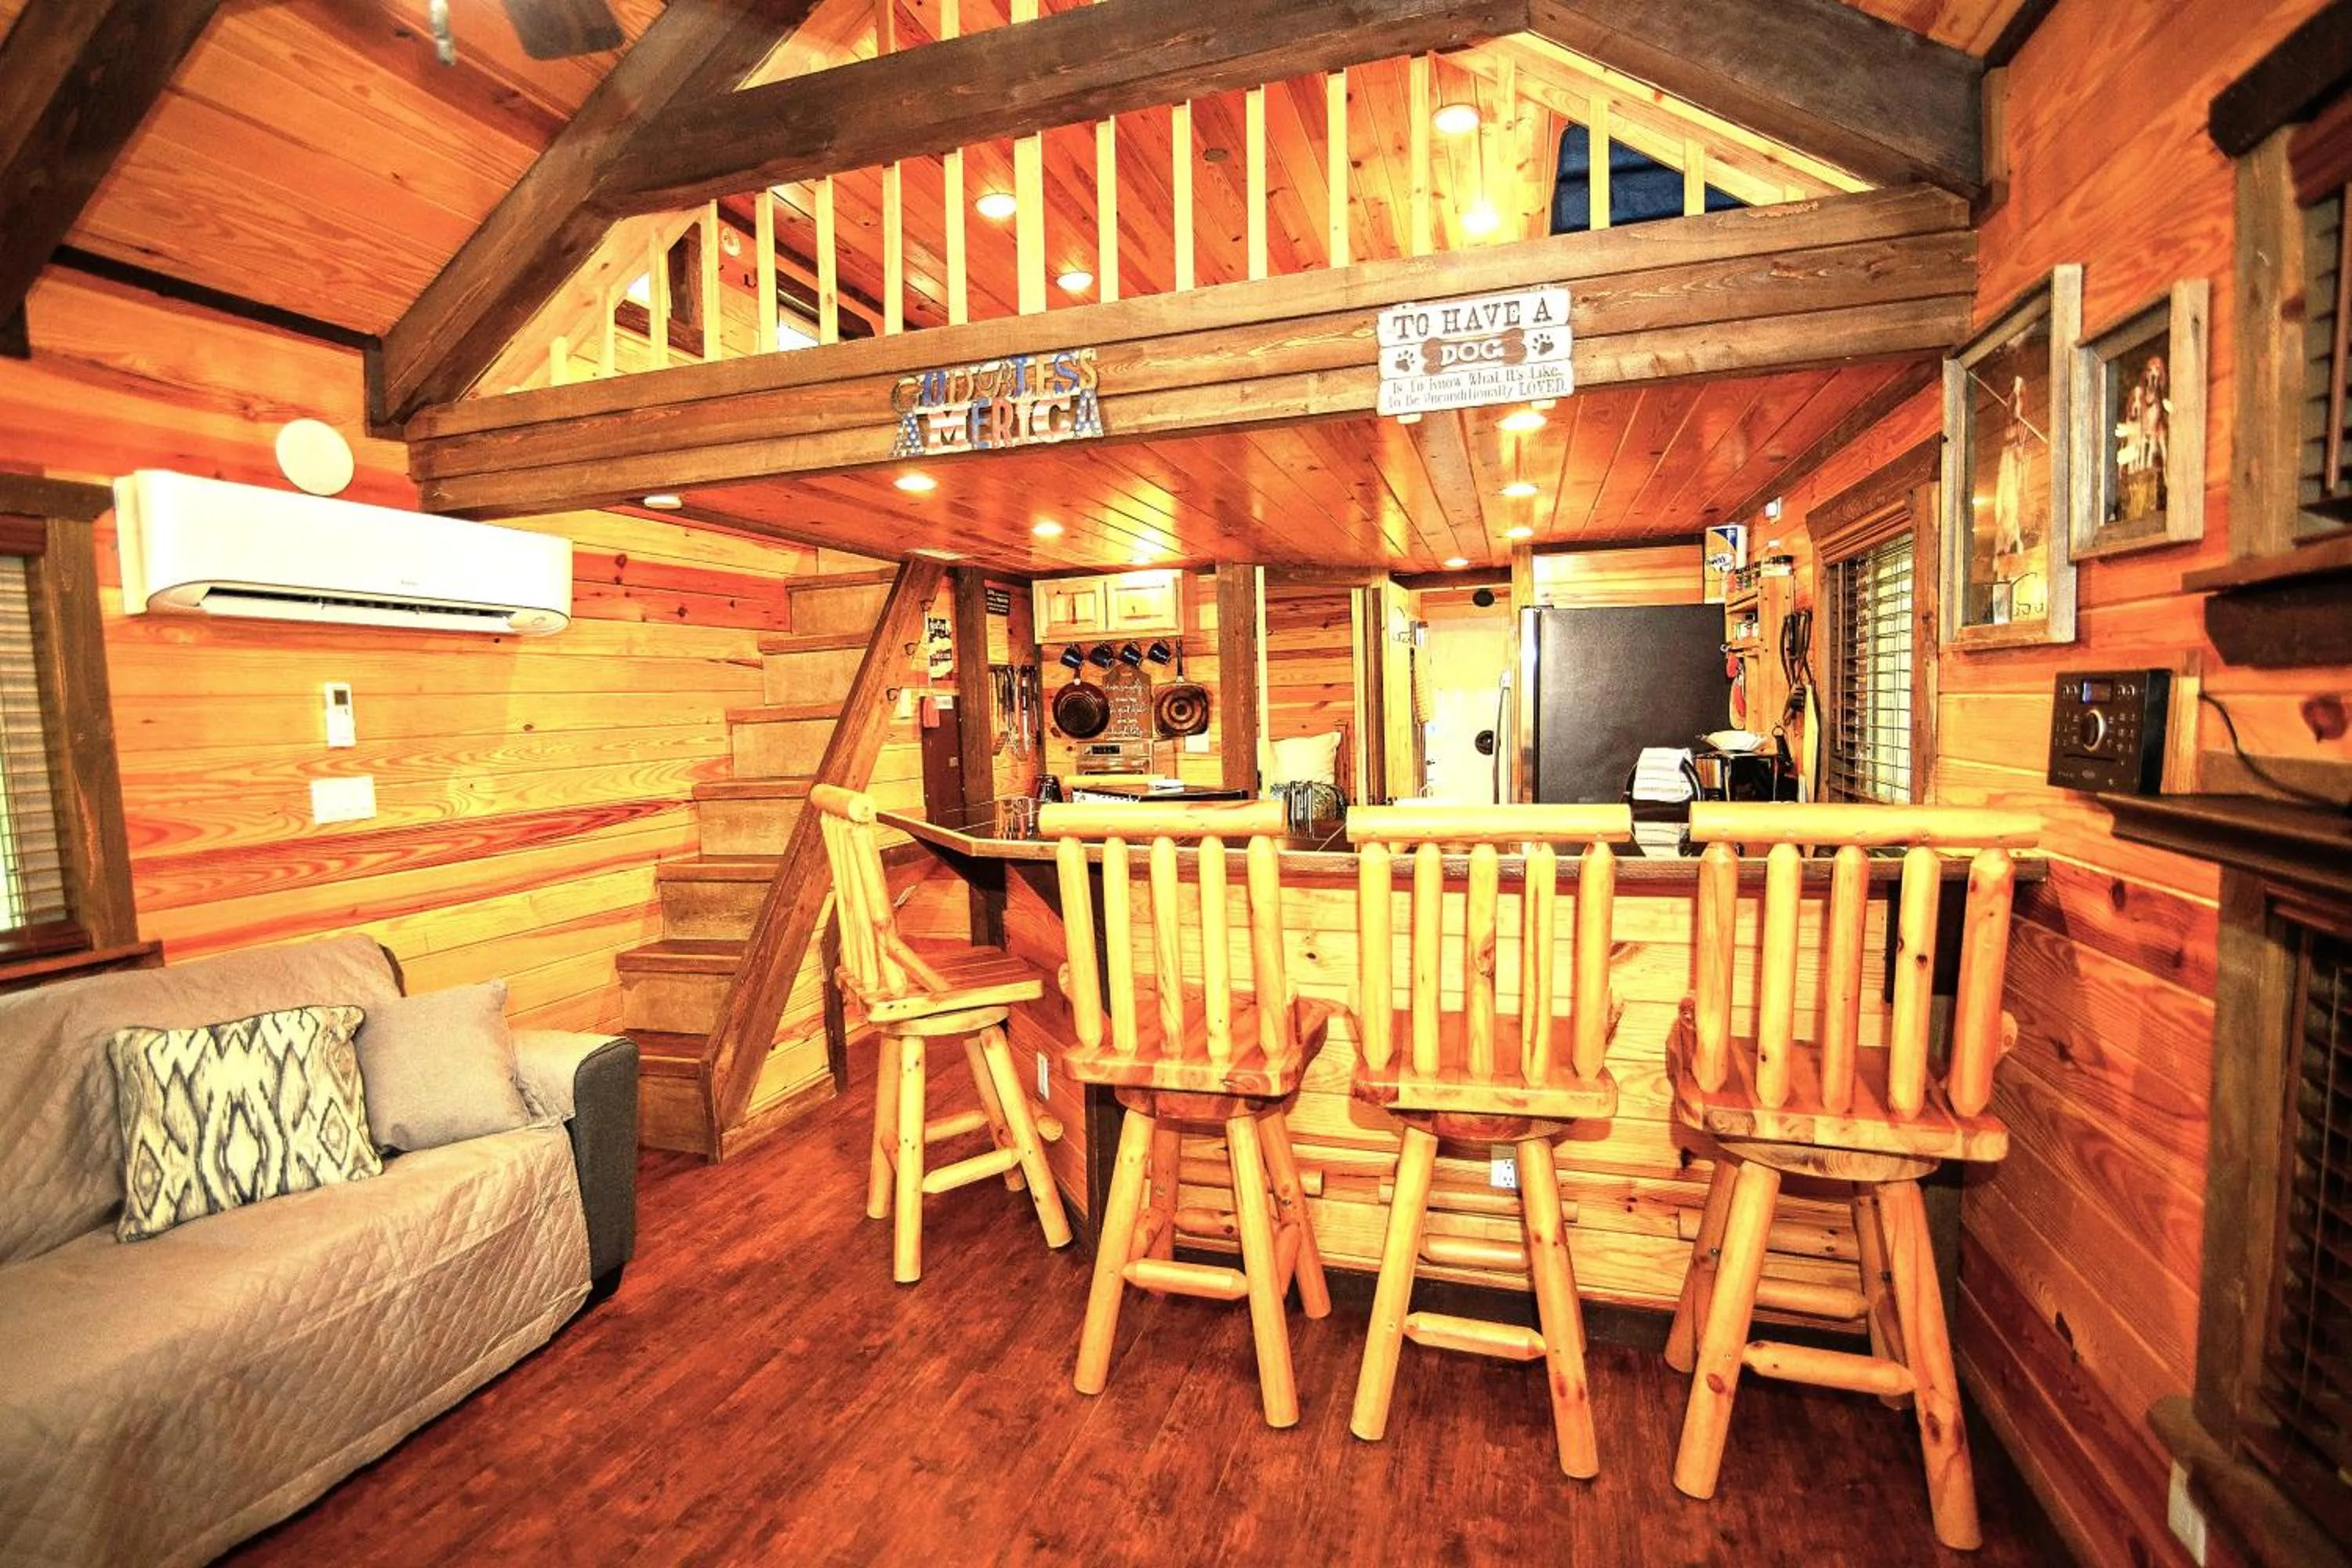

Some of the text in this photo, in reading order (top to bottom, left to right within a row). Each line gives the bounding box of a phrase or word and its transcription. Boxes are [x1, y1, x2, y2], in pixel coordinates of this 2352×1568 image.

[1392, 296, 1552, 340] TO HAVE A
[1439, 339, 1505, 365] DOG
[890, 388, 1105, 457] AMERICA
